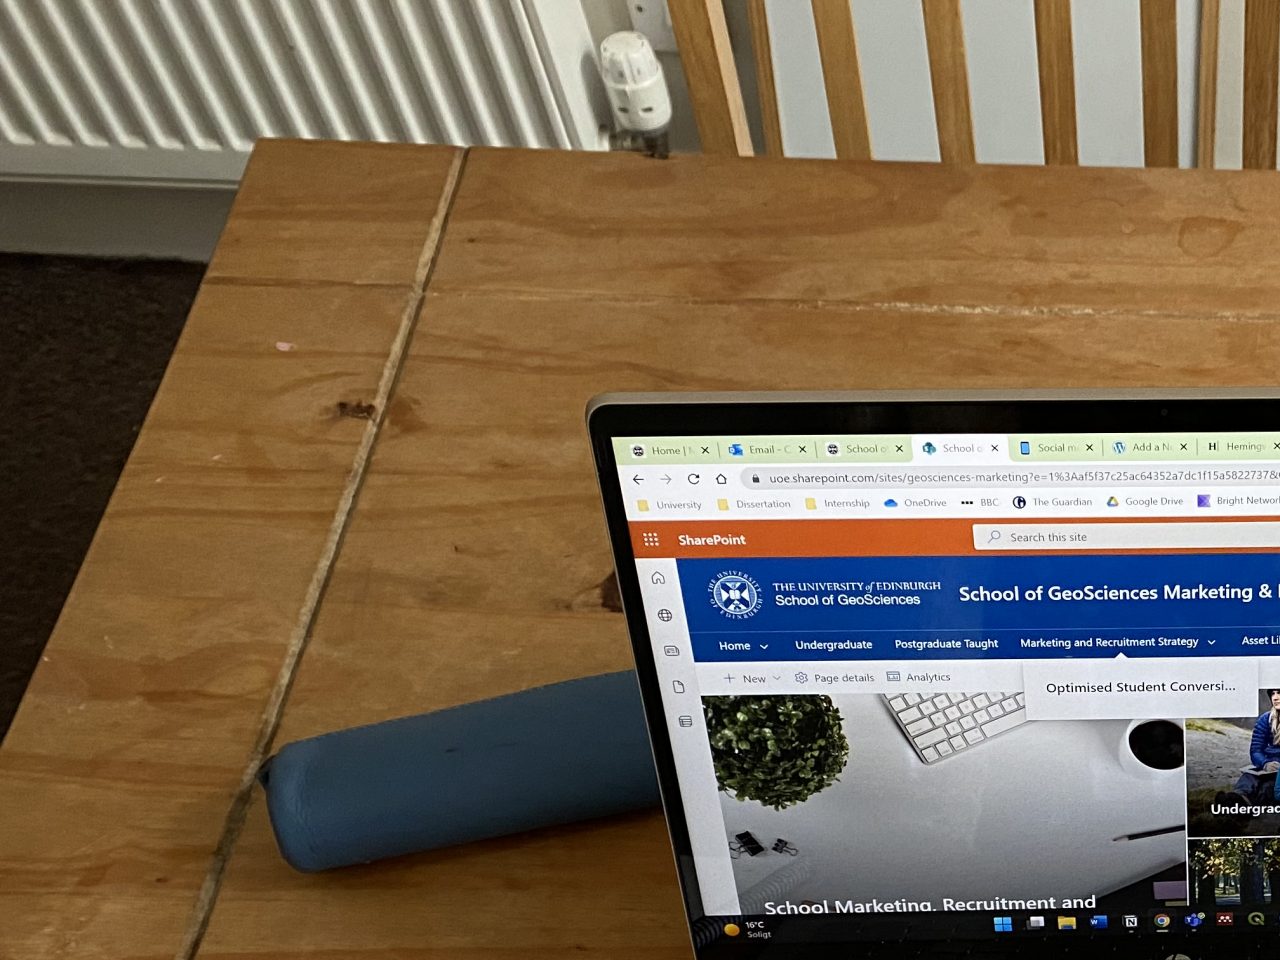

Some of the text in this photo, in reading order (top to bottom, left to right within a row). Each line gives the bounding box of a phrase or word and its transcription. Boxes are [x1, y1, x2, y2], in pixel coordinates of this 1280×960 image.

[652, 446, 680, 456] Home
[750, 445, 775, 454] Email
[846, 444, 875, 454] School
[942, 443, 974, 454] School
[1038, 442, 1066, 453] Social
[1132, 442, 1152, 452] Add
[656, 500, 702, 510] University
[736, 499, 791, 509] Dissertation
[824, 498, 870, 510] Internship
[904, 498, 947, 507] OneDrive
[980, 498, 999, 507] BBC
[1032, 497, 1093, 507] The Guardian
[1125, 496, 1184, 508] Google Drive
[1217, 495, 1244, 507] Bright
[678, 534, 746, 546] SharePoint
[1010, 532, 1087, 543] Search this site
[772, 581, 941, 593] THE UNIVERSITY of EDINBURGH
[958, 585, 1020, 602] School
[1024, 585, 1044, 601] of
[1048, 585, 1158, 601] GeoSciences
[1163, 583, 1253, 602] Marketing
[1258, 583, 1272, 598] &
[775, 594, 920, 606] School of GeoSciences
[718, 640, 751, 651] Home
[795, 640, 873, 652] Undergraduate
[894, 638, 998, 652] Postgraduate Taught
[1020, 637, 1199, 650] Marketing and Recruitment Strategy
[1241, 636, 1269, 646] Asset
[743, 674, 766, 684] New
[814, 673, 876, 686] Page details
[906, 672, 951, 684] Analytics
[1046, 682, 1113, 695] Optimised
[1116, 682, 1166, 693] Student
[764, 901, 829, 916] School
[943, 896, 1056, 912] Recruitment
[1062, 894, 1096, 910] and
[745, 921, 764, 929] 16°C
[747, 930, 772, 939] Soligt
